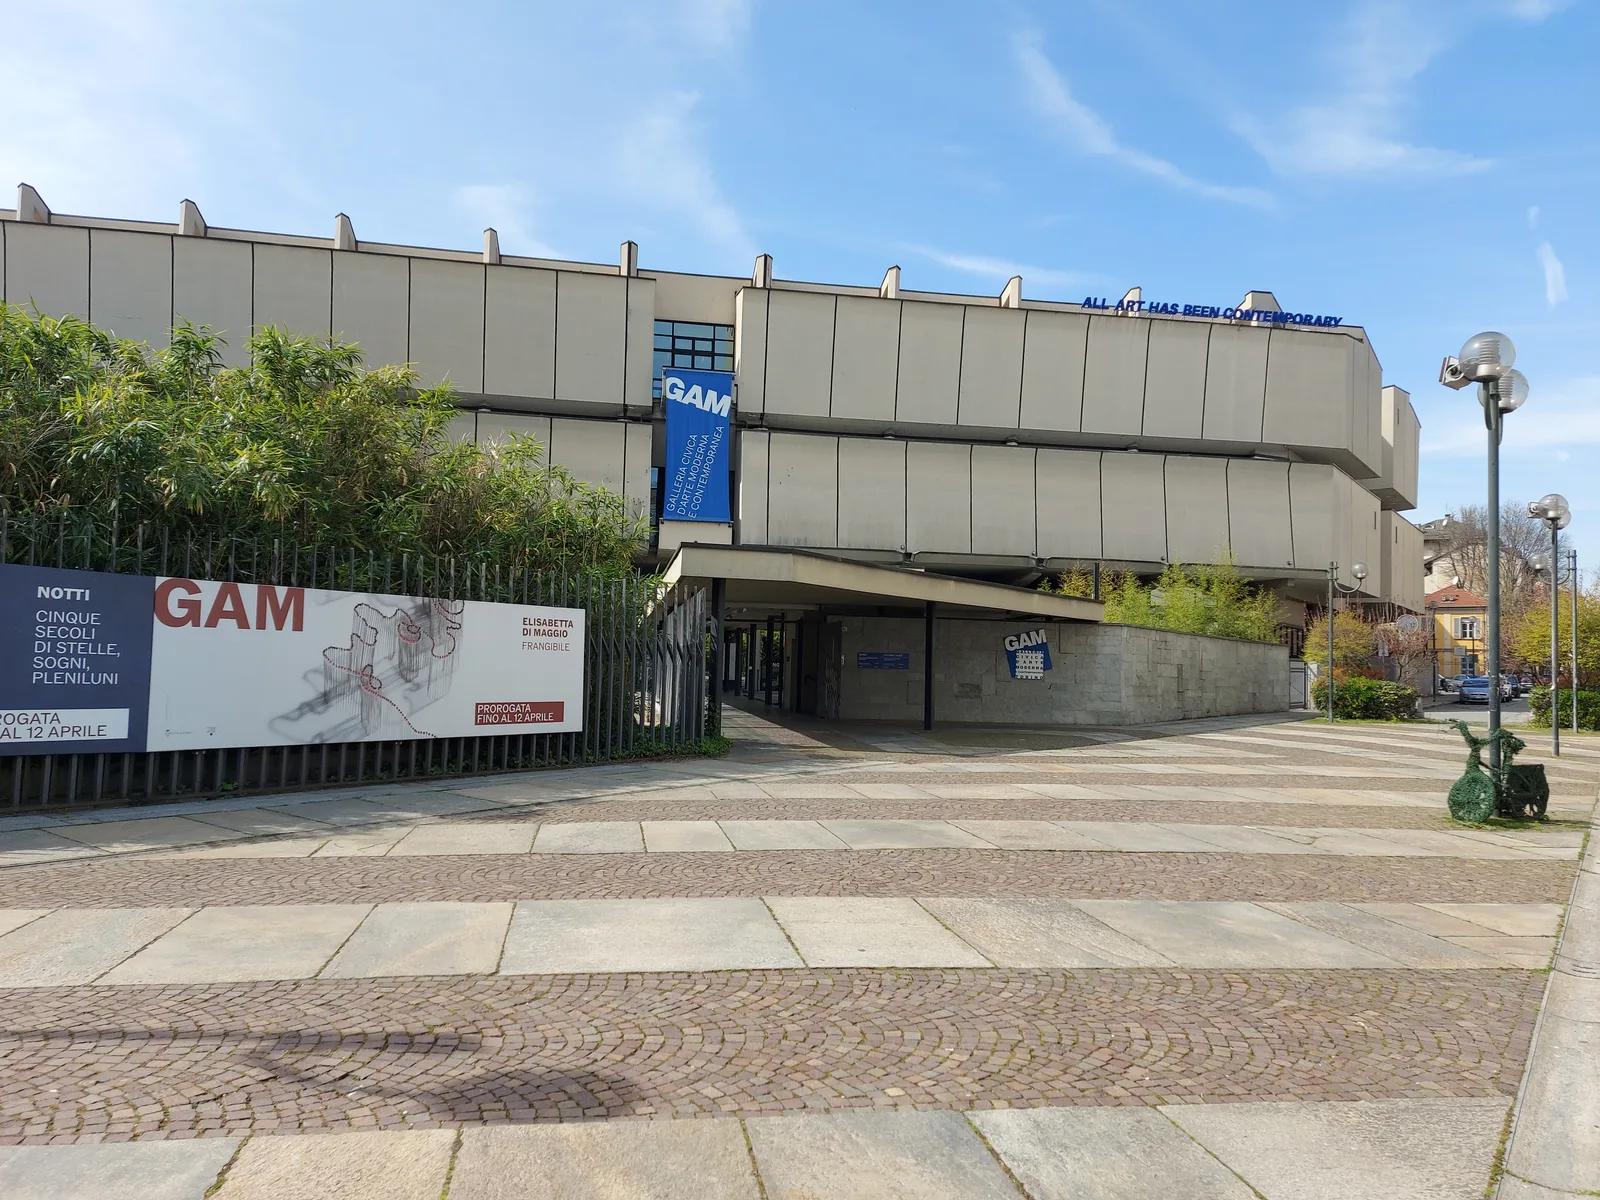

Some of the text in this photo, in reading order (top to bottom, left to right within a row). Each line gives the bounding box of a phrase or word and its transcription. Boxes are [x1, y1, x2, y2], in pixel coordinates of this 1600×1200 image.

[1081, 296, 1343, 328] ALL ART HAS BEEN CONTEMPORARY
[665, 377, 731, 418] GAM
[667, 434, 698, 511] GALLERIA CIVICA
[677, 434, 710, 515] D'ARTE MODERNA
[688, 426, 724, 519] E CONTEMPORANEA
[37, 586, 90, 601] NOTTI
[154, 578, 304, 632] GAM
[36, 610, 101, 625] CINQUE
[522, 617, 574, 629] ELISABETTA
[34, 625, 95, 640] SECOLI
[522, 628, 568, 638] DI MAGGIO
[1004, 628, 1047, 651] GAM
[34, 641, 121, 657] DI STELLE,
[522, 641, 570, 652] FRANGIBILE
[33, 657, 90, 672] SOGNI,
[32, 672, 118, 685] PLENILUNI
[477, 704, 531, 714] PROROGATA
[0, 712, 61, 725] OGATA
[477, 713, 554, 723] FINO AL 12 APRILE
[0, 725, 107, 739] AL 12 APRILE
